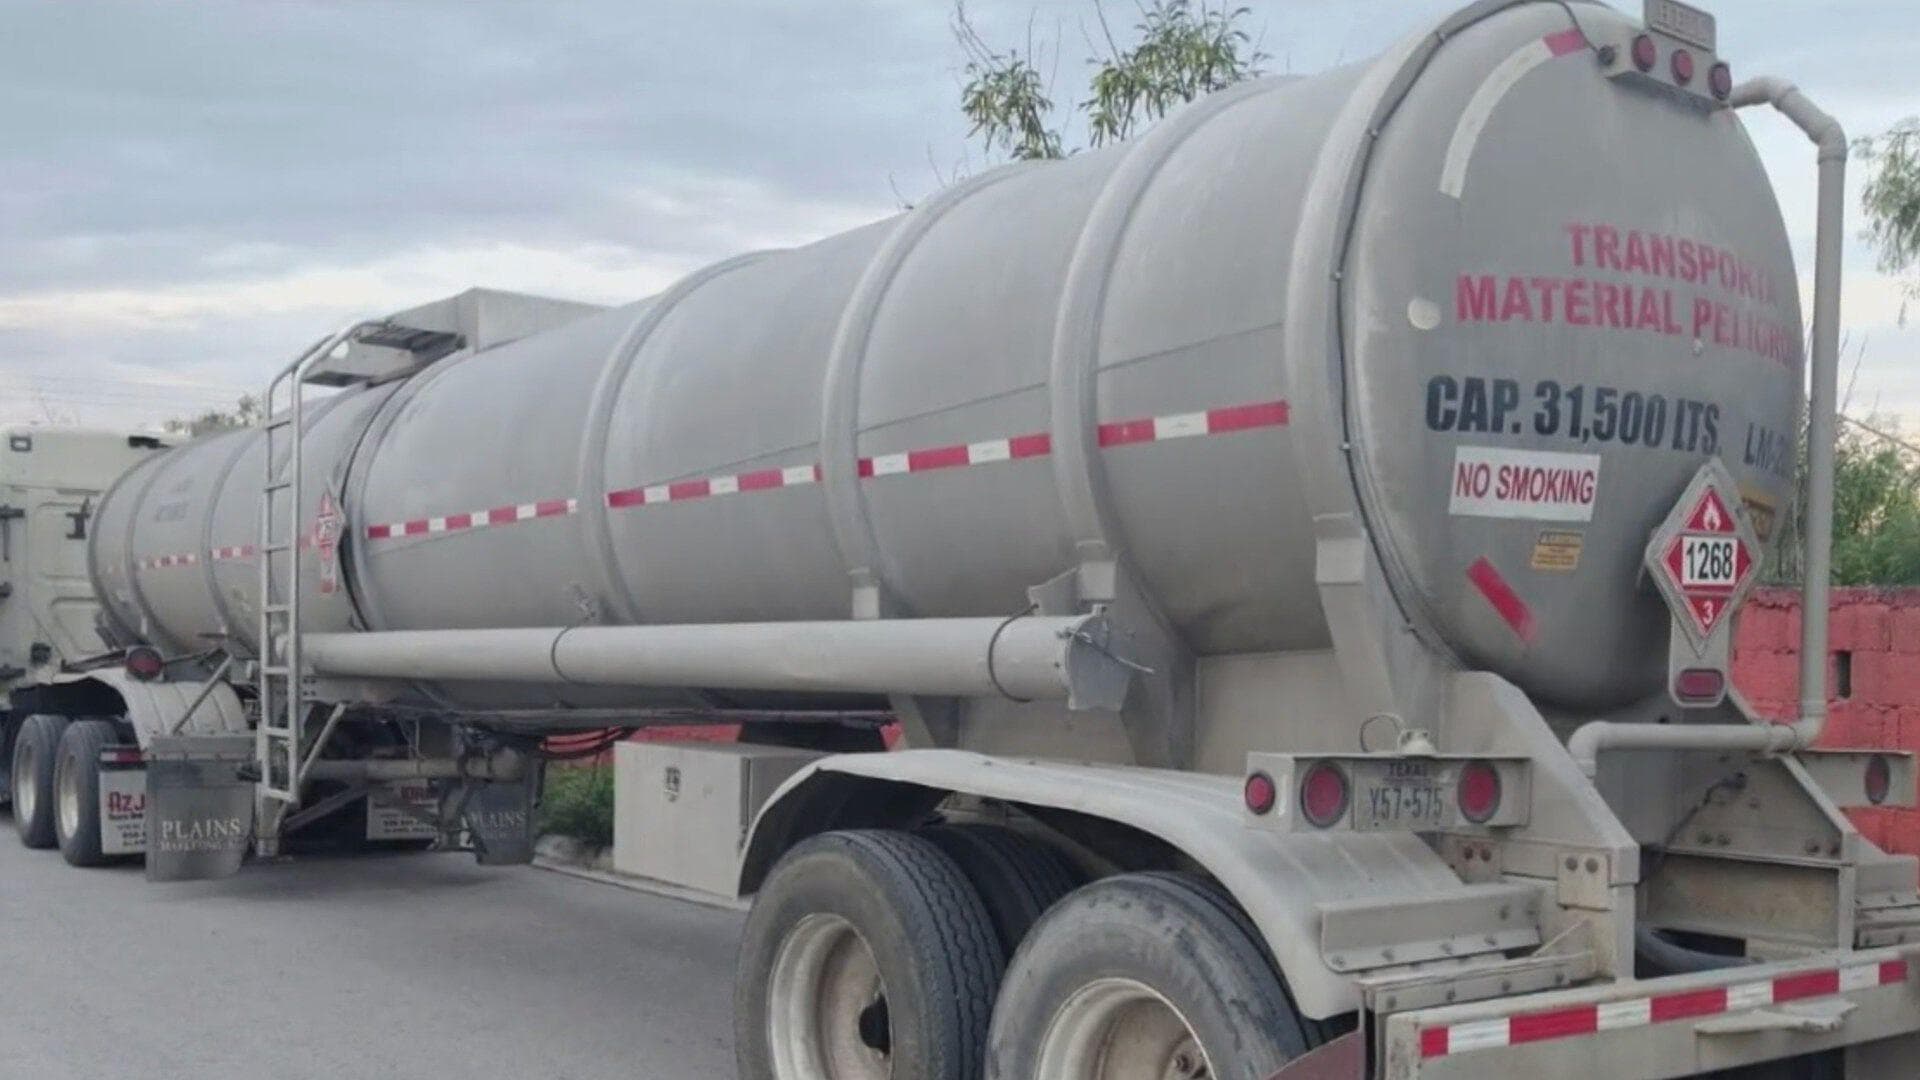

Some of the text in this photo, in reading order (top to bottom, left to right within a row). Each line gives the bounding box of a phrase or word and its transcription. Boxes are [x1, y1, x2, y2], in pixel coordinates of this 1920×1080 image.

[1456, 274, 1682, 335] MATERIAL
[1425, 375, 1522, 432] CAP.
[1534, 380, 1667, 443] 31,500
[1455, 463, 1595, 505] NO SMOKING
[1686, 542, 1734, 581] 1268
[1703, 600, 1714, 626] 3
[161, 818, 241, 839] PLAINS
